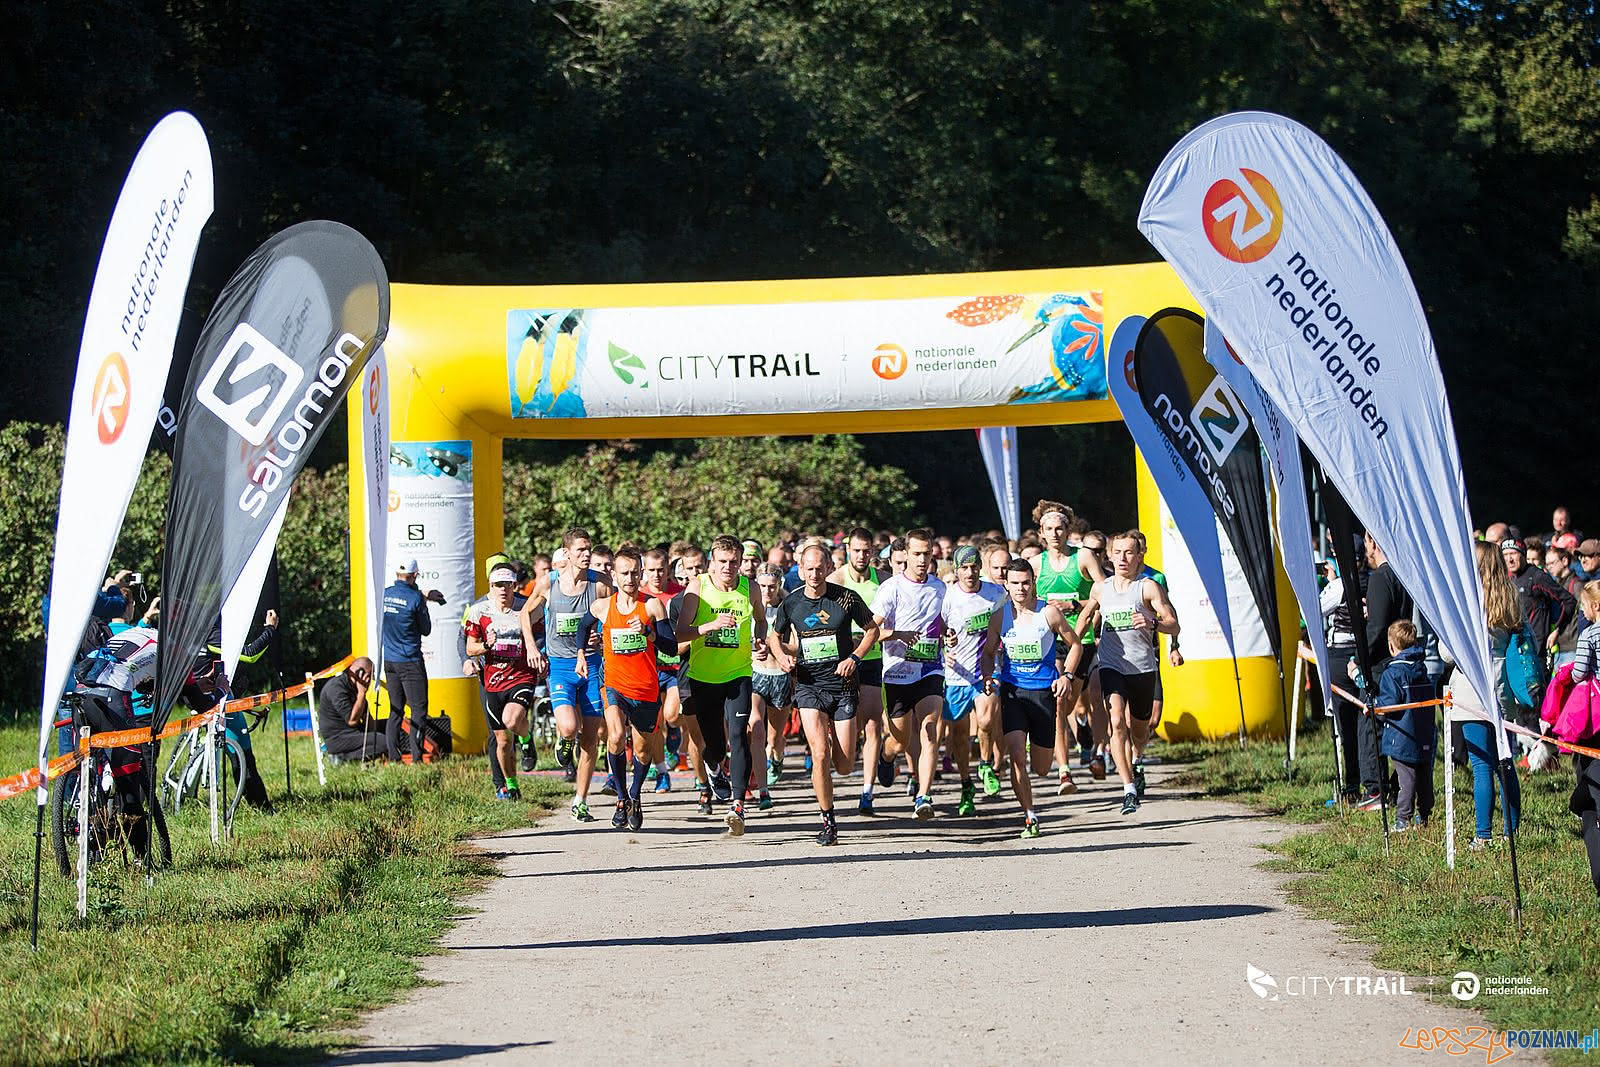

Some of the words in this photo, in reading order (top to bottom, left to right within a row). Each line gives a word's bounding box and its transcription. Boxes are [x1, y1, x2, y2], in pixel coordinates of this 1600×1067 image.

[121, 198, 168, 335] nationale
[131, 169, 193, 351] nederlanden
[1286, 252, 1381, 376] nationale
[915, 345, 975, 358] nationale
[1265, 273, 1389, 440] nederlanden
[915, 358, 997, 372] nederlanden
[239, 332, 365, 518] salomon
[405, 500, 455, 508] nederlanden
[622, 633, 642, 644] 295
[819, 642, 827, 652] 2
[1018, 644, 1038, 654] 366
